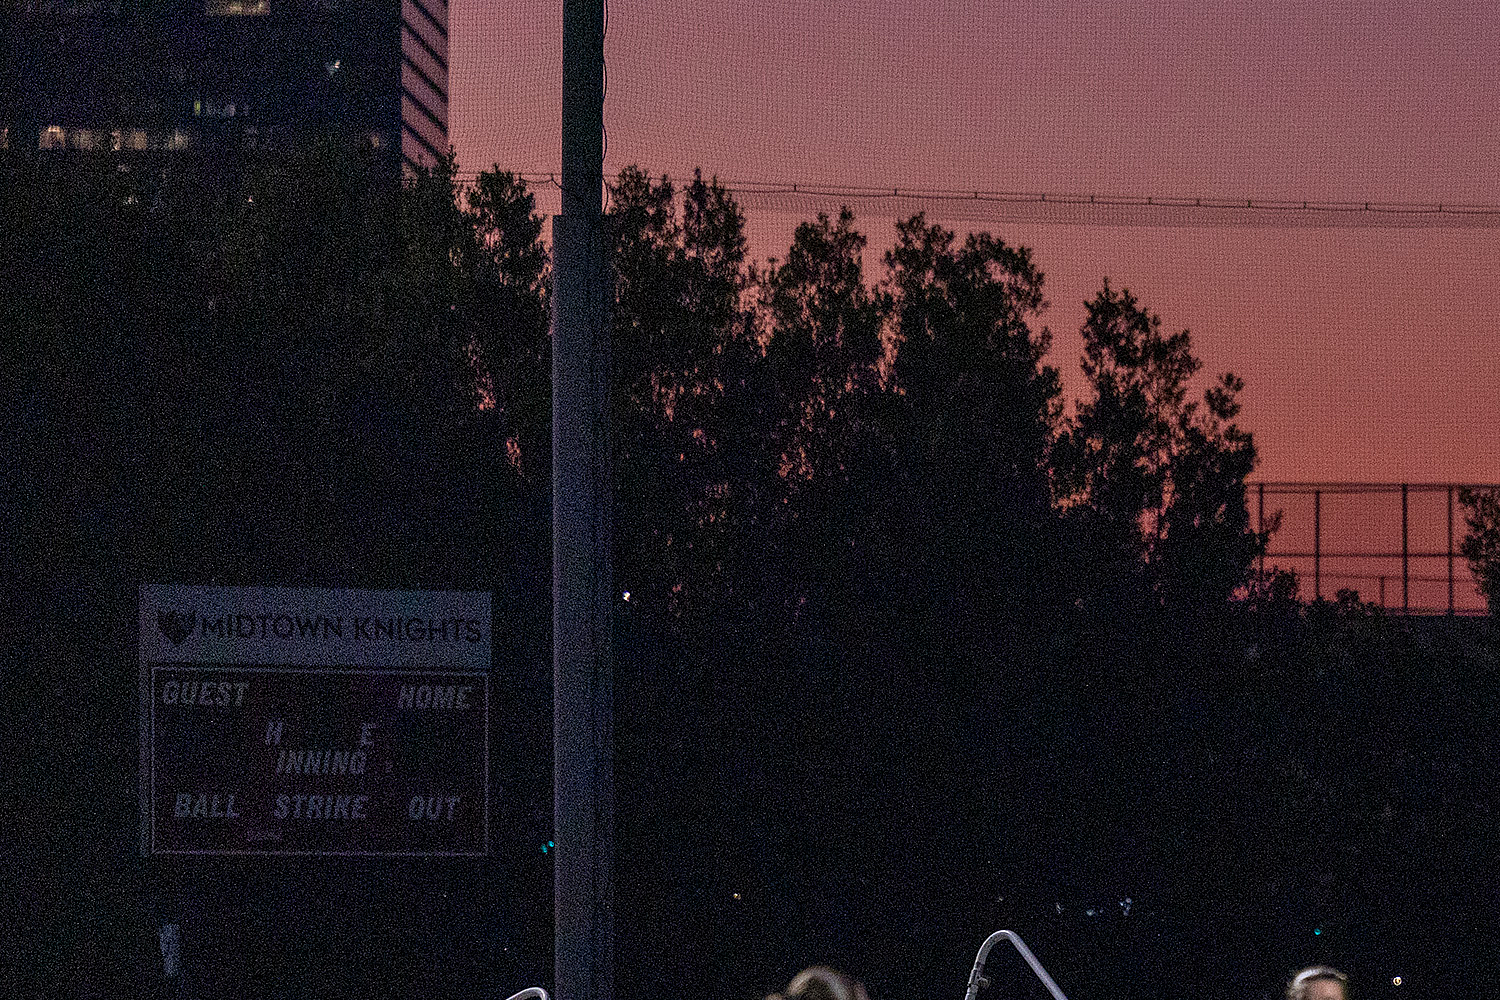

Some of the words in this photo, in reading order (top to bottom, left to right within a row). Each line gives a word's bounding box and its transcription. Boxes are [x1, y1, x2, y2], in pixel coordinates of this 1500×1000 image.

[201, 613, 344, 640] MIDTOWN
[353, 616, 483, 643] KNIGHTS
[162, 680, 250, 707] GUEST
[397, 684, 473, 710] HOME
[264, 720, 284, 746] H
[359, 722, 378, 747] E
[275, 750, 367, 776] INNING
[173, 793, 241, 819] BALL
[273, 794, 370, 820] STRIKE
[408, 795, 461, 821] OUT
